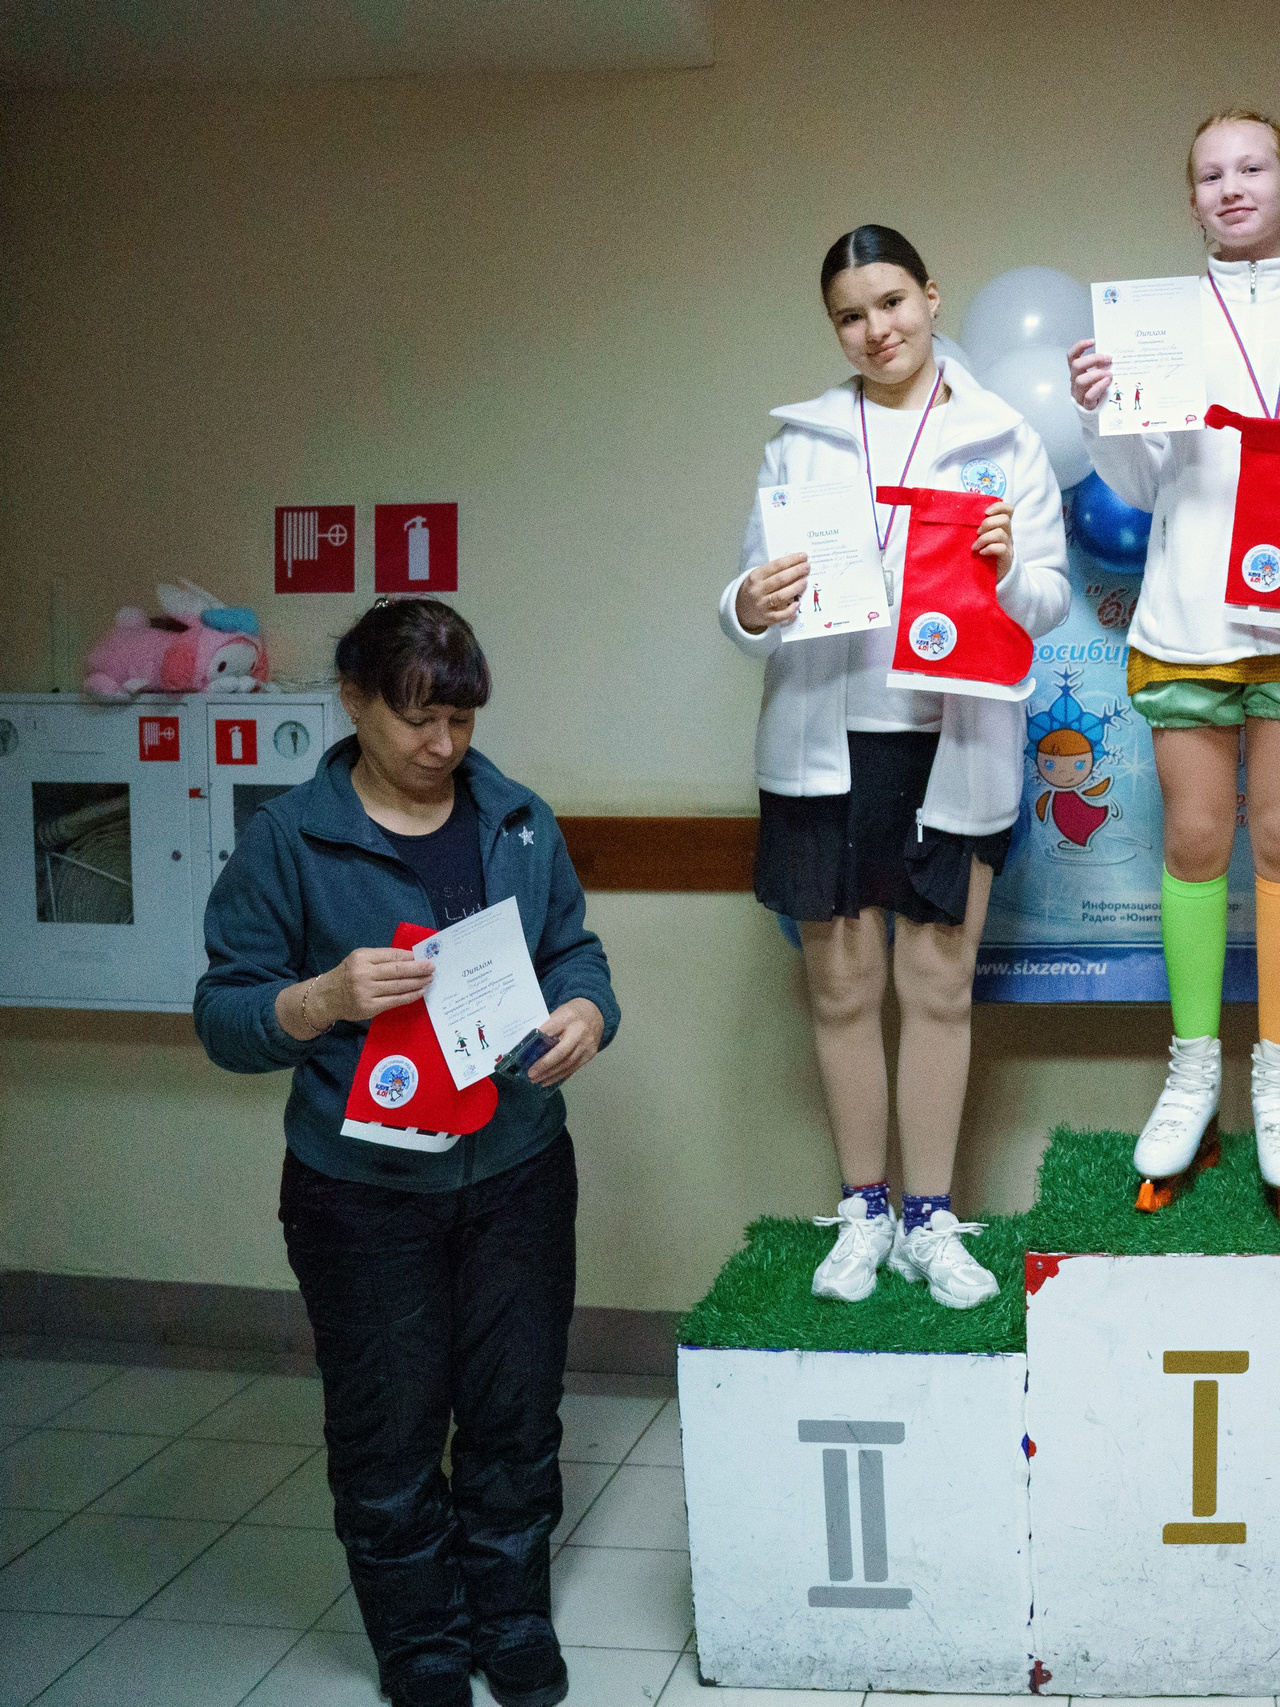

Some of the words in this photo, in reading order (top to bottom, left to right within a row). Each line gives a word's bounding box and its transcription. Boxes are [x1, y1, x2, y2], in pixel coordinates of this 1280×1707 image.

[807, 529, 839, 538] Диплом
[1081, 913, 1117, 922] Радио
[462, 960, 493, 978] Диплом
